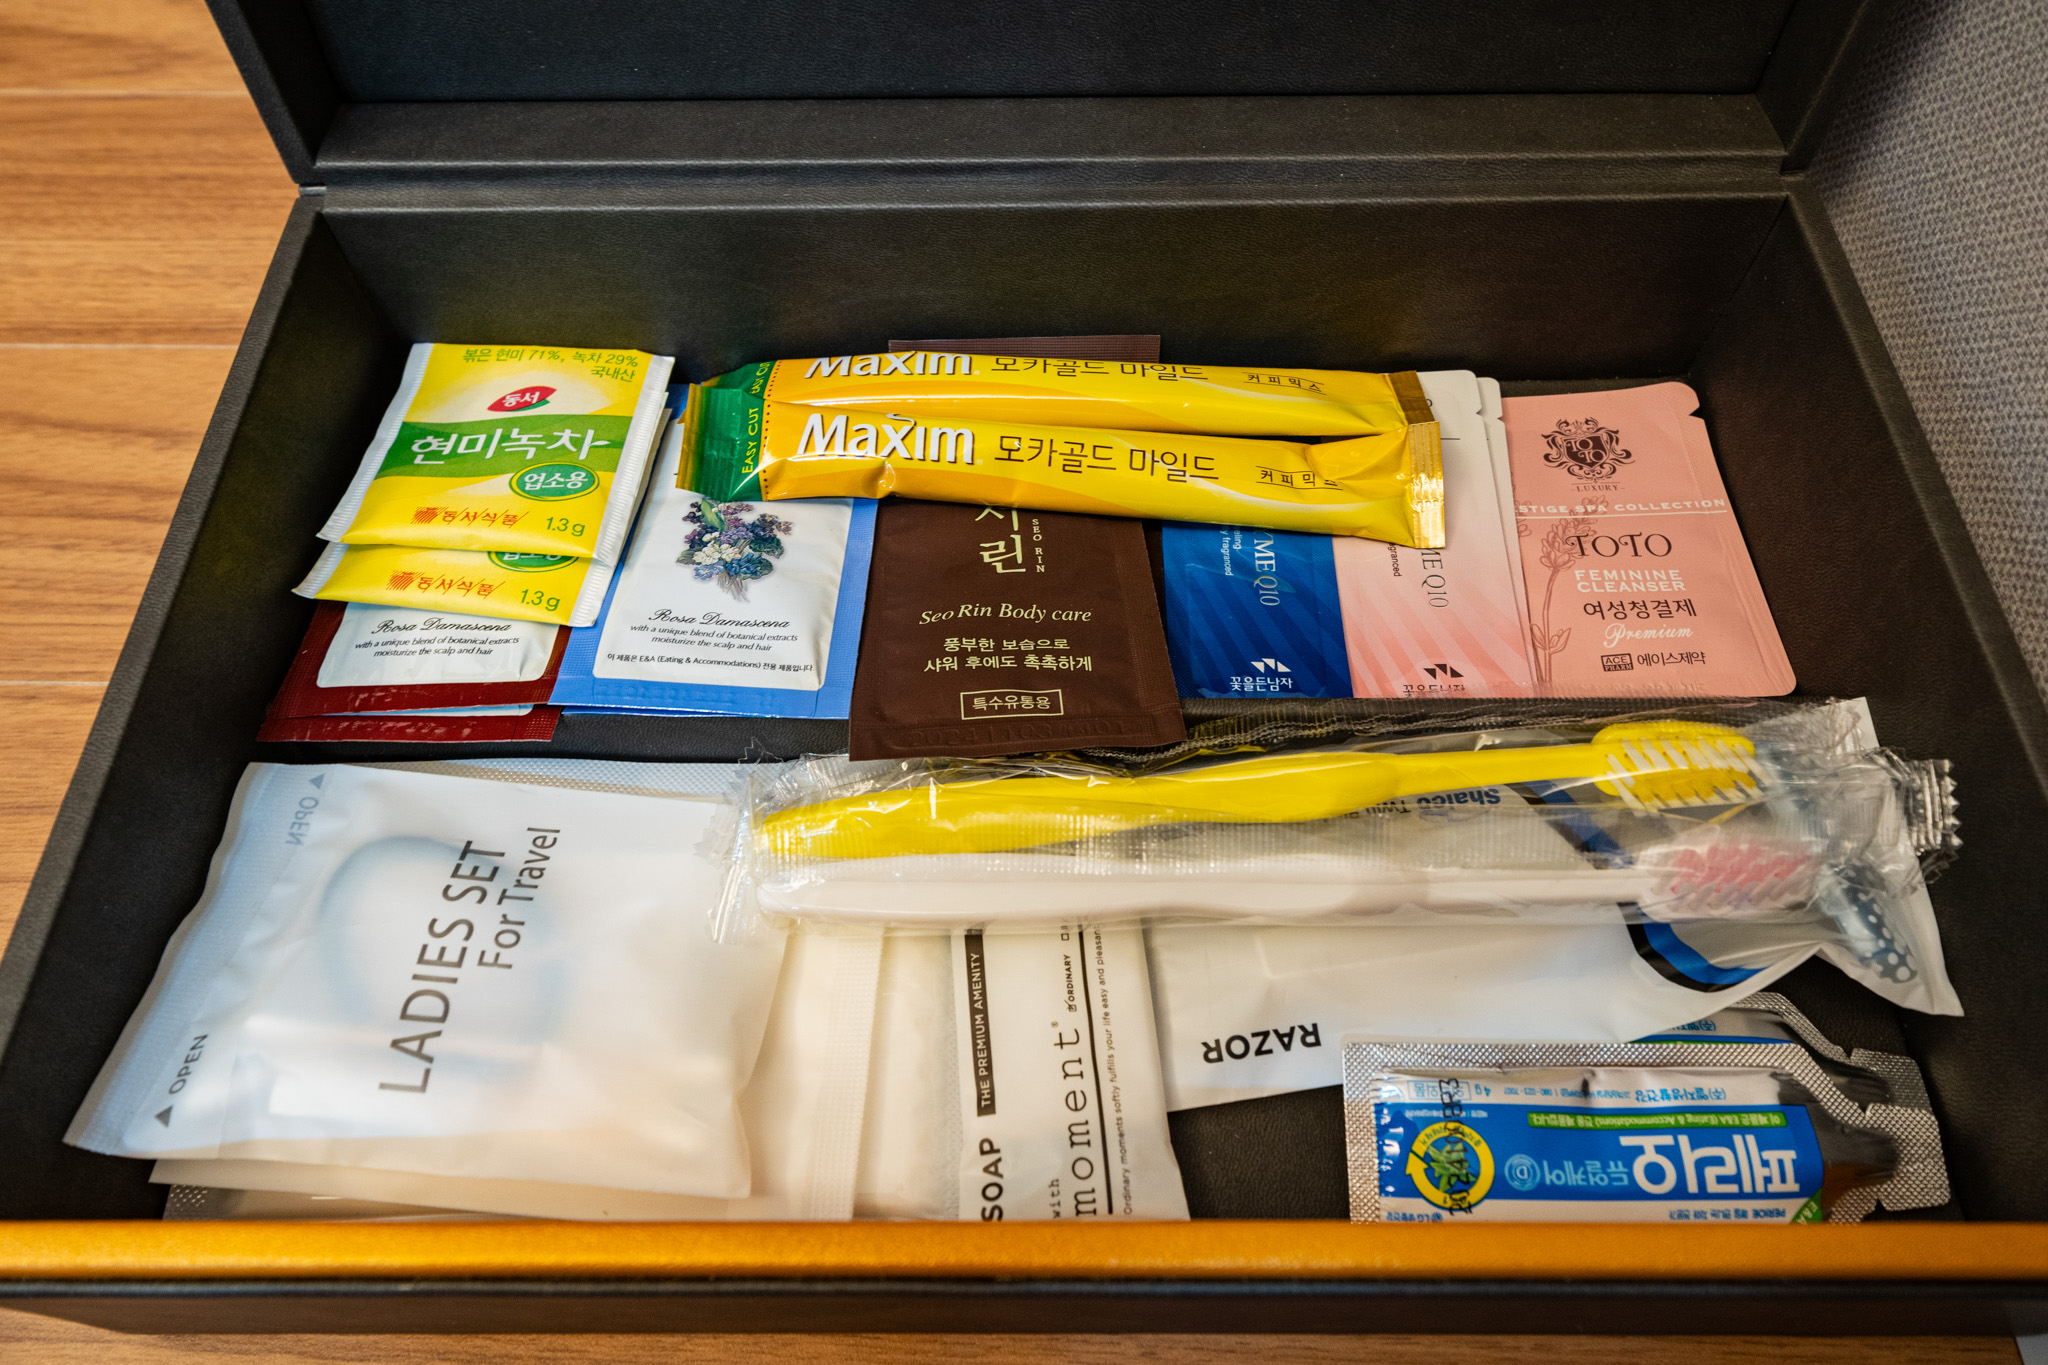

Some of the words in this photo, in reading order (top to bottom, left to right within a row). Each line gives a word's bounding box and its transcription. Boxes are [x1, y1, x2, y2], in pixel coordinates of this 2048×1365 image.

[463, 348, 491, 363] 볶은
[496, 348, 523, 362] 현미
[529, 349, 565, 363] 71%,
[573, 351, 603, 364] 녹차
[605, 354, 638, 367] 29%
[804, 350, 972, 378] Maxim
[991, 357, 1110, 377] 모카골드
[1121, 363, 1209, 382] 마일드
[591, 365, 636, 383] 국내산
[502, 391, 541, 408] 동서
[748, 408, 759, 436] CUT
[410, 427, 611, 465] 현미녹차
[797, 412, 976, 465] Maxim
[742, 441, 758, 474] EASY
[994, 435, 1117, 475] 모카골드
[1129, 447, 1219, 484] 마일드
[524, 472, 589, 492] 업소용
[1576, 484, 1618, 492] LUXURY
[441, 507, 529, 528] 동서식품
[1515, 504, 1568, 514] STIGE
[1575, 503, 1607, 513] SPA
[1615, 498, 1726, 512] COLLECTION
[1032, 518, 1043, 541] SEO
[1222, 535, 1234, 577] fragranced
[1565, 532, 1672, 558] TOTO
[1034, 547, 1046, 573] RIN
[1389, 542, 1402, 577] agranced
[1574, 569, 1682, 581] FEMININE
[1577, 581, 1686, 593] CLEANSER
[1253, 574, 1281, 606] Q10
[1421, 574, 1449, 609] Q10
[648, 608, 697, 624] Rosa
[699, 611, 791, 628] Damascena
[919, 609, 954, 625] Seo
[958, 603, 992, 618] Rin
[998, 603, 1047, 623] Body
[1051, 608, 1092, 622] care
[1583, 598, 1697, 621] 여성청결제
[371, 619, 417, 635] Rosa
[420, 617, 512, 633] Damascena
[630, 624, 650, 632] with
[658, 628, 689, 637] unique
[690, 629, 715, 638] blend
[726, 631, 766, 641] botanical
[766, 633, 798, 642] extracts
[1603, 622, 1693, 649] Premium
[355, 640, 372, 649] with
[381, 638, 410, 648] unique
[411, 637, 437, 646] blend
[447, 636, 488, 645] botanical
[489, 637, 520, 645] extracts
[374, 648, 417, 658] moisturize
[419, 647, 432, 656] the
[433, 646, 455, 657] scalp
[457, 647, 474, 656] and
[475, 647, 493, 656] hair
[651, 636, 696, 646] moisturize
[697, 639, 712, 647] the
[713, 641, 736, 650] scalp
[736, 642, 755, 651] and
[755, 643, 773, 652] hair
[943, 637, 995, 653] 풍부한
[1002, 638, 1071, 651] 보습으로
[607, 653, 616, 662] 이
[616, 653, 639, 663] 제품은
[639, 655, 656, 663] E&A
[657, 656, 684, 665] (Eating
[692, 657, 762, 670] Accommodations)
[924, 656, 958, 673] 샤워
[965, 656, 1018, 670] 후에도
[1023, 655, 1093, 672] 촉촉하게
[1604, 664, 1633, 672] PHARM
[1605, 654, 1628, 665] ACE
[1637, 651, 1706, 667] 에이스제약
[1229, 675, 1293, 692] 꽃을든남자
[972, 694, 1051, 711] 특수유통용
[498, 826, 562, 907] Travel
[477, 913, 527, 970] For
[378, 916, 476, 1095] LADIES
[442, 839, 506, 905] SET
[1063, 954, 1075, 1002] ORDINARY
[1096, 968, 1106, 986] and
[969, 952, 984, 1010] AMENITY
[1100, 988, 1109, 1009] easy
[1102, 1011, 1111, 1026] life
[974, 1013, 988, 1077] PREMIUM
[1105, 1028, 1114, 1051] your
[1200, 1022, 1322, 1064] RAZOR
[167, 1033, 209, 1096] OPEN
[1107, 1050, 1118, 1082] fulfills
[980, 1079, 991, 1108] THE
[1111, 1083, 1122, 1114] softly
[1054, 1027, 1097, 1218] moment
[1115, 1118, 1128, 1165] moments
[1542, 1159, 1630, 1187] 듀얼케어
[1619, 1134, 1801, 1195] 페리오
[978, 1137, 1004, 1222] SOAP
[1121, 1168, 1133, 1215] Ordinary
[1049, 1178, 1061, 1219] with
